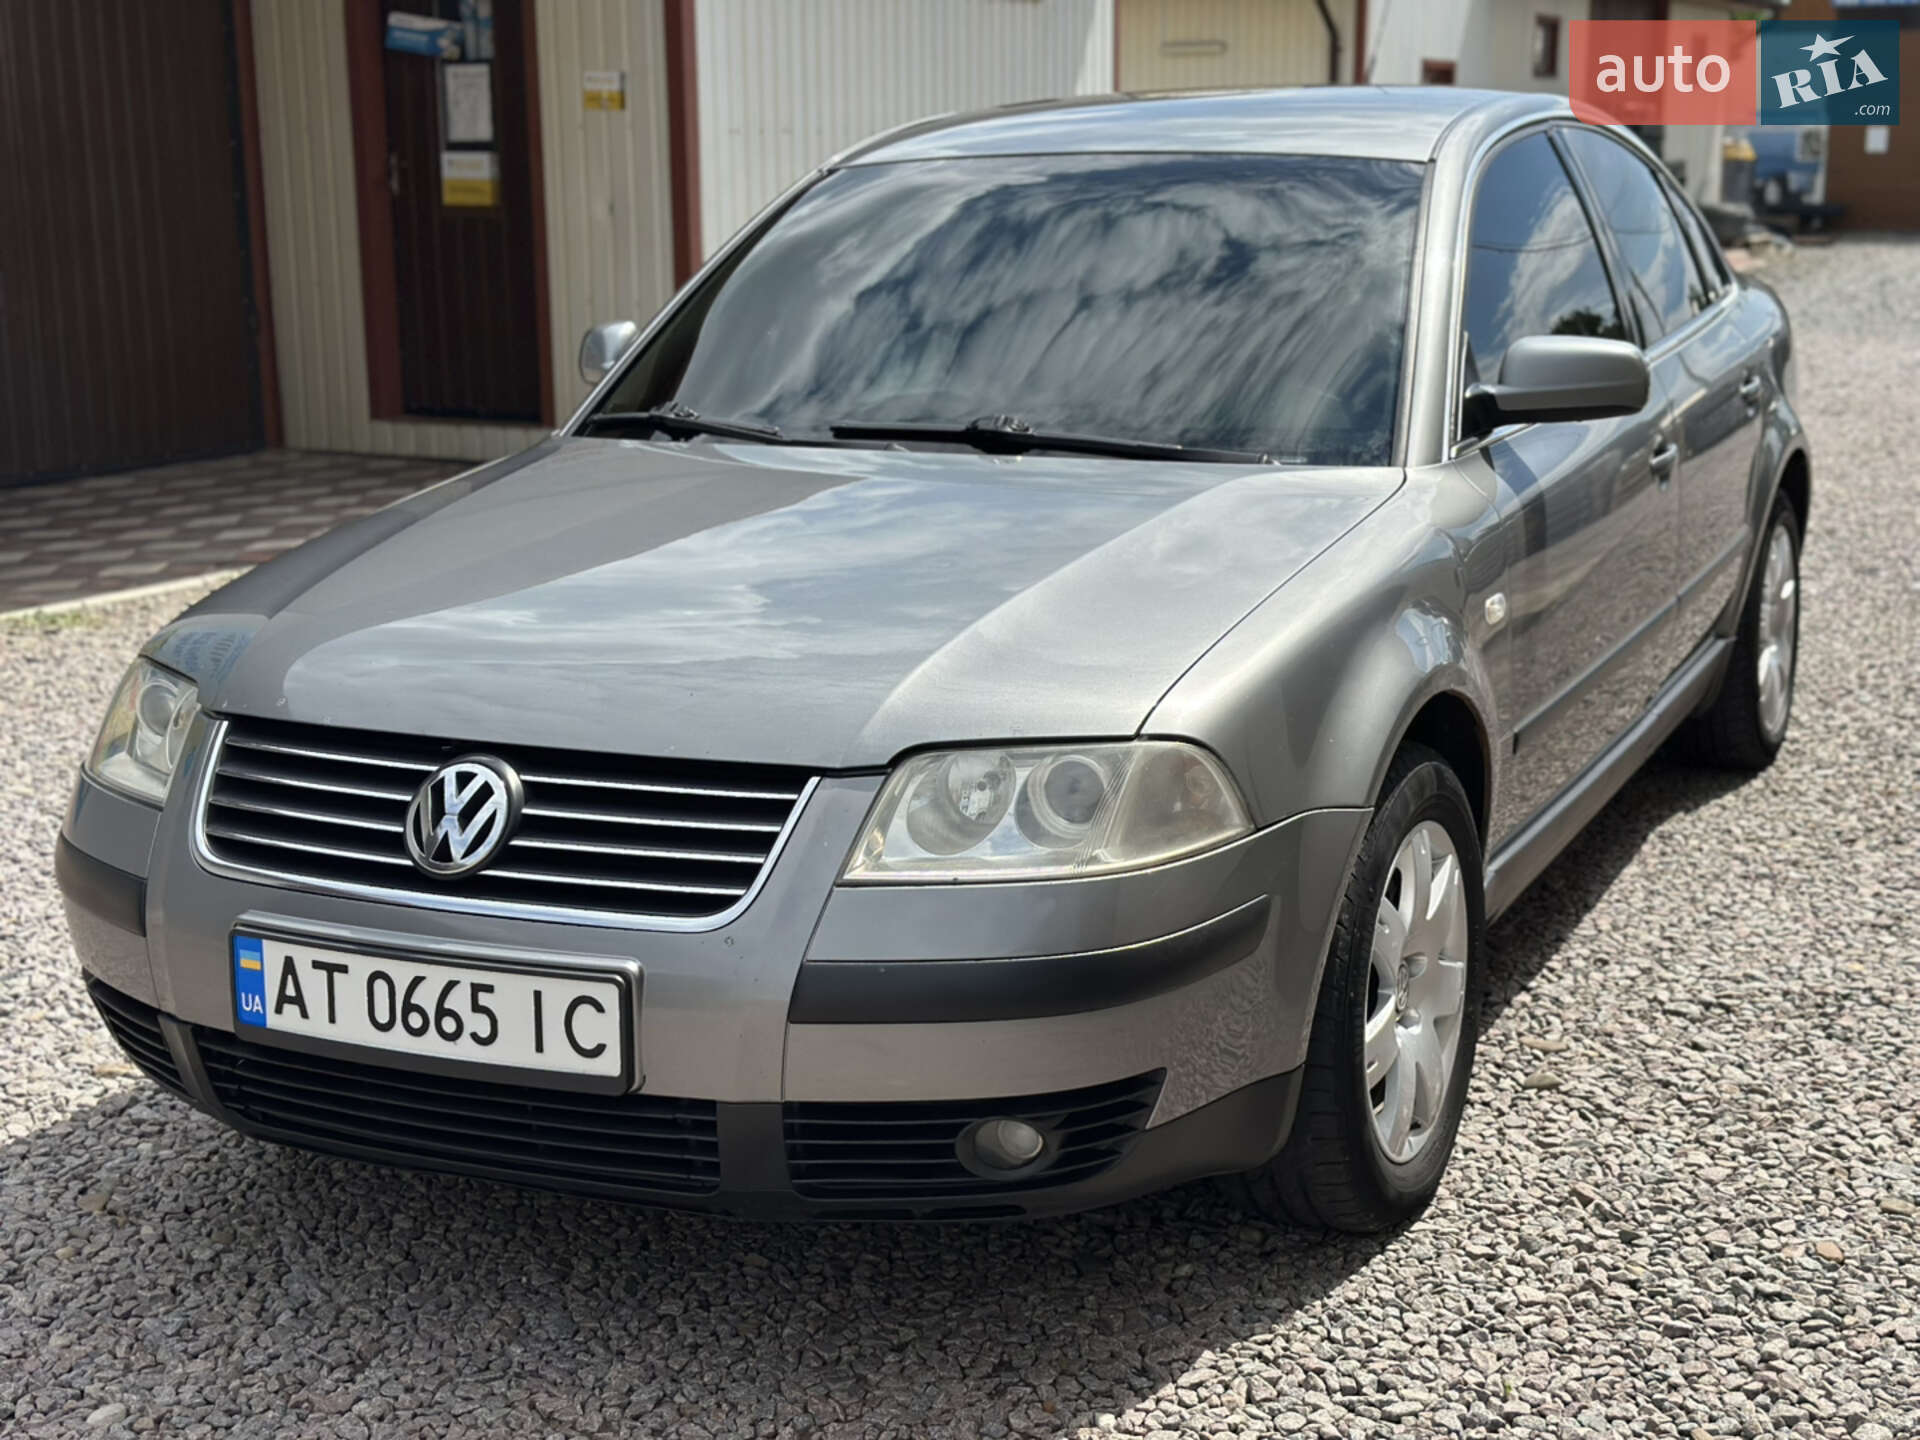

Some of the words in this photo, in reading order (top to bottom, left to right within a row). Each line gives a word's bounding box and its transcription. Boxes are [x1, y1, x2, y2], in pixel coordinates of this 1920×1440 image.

[241, 992, 263, 1015] UA
[274, 955, 349, 1024] AT
[366, 969, 499, 1046] 0665
[534, 989, 608, 1059] IC
